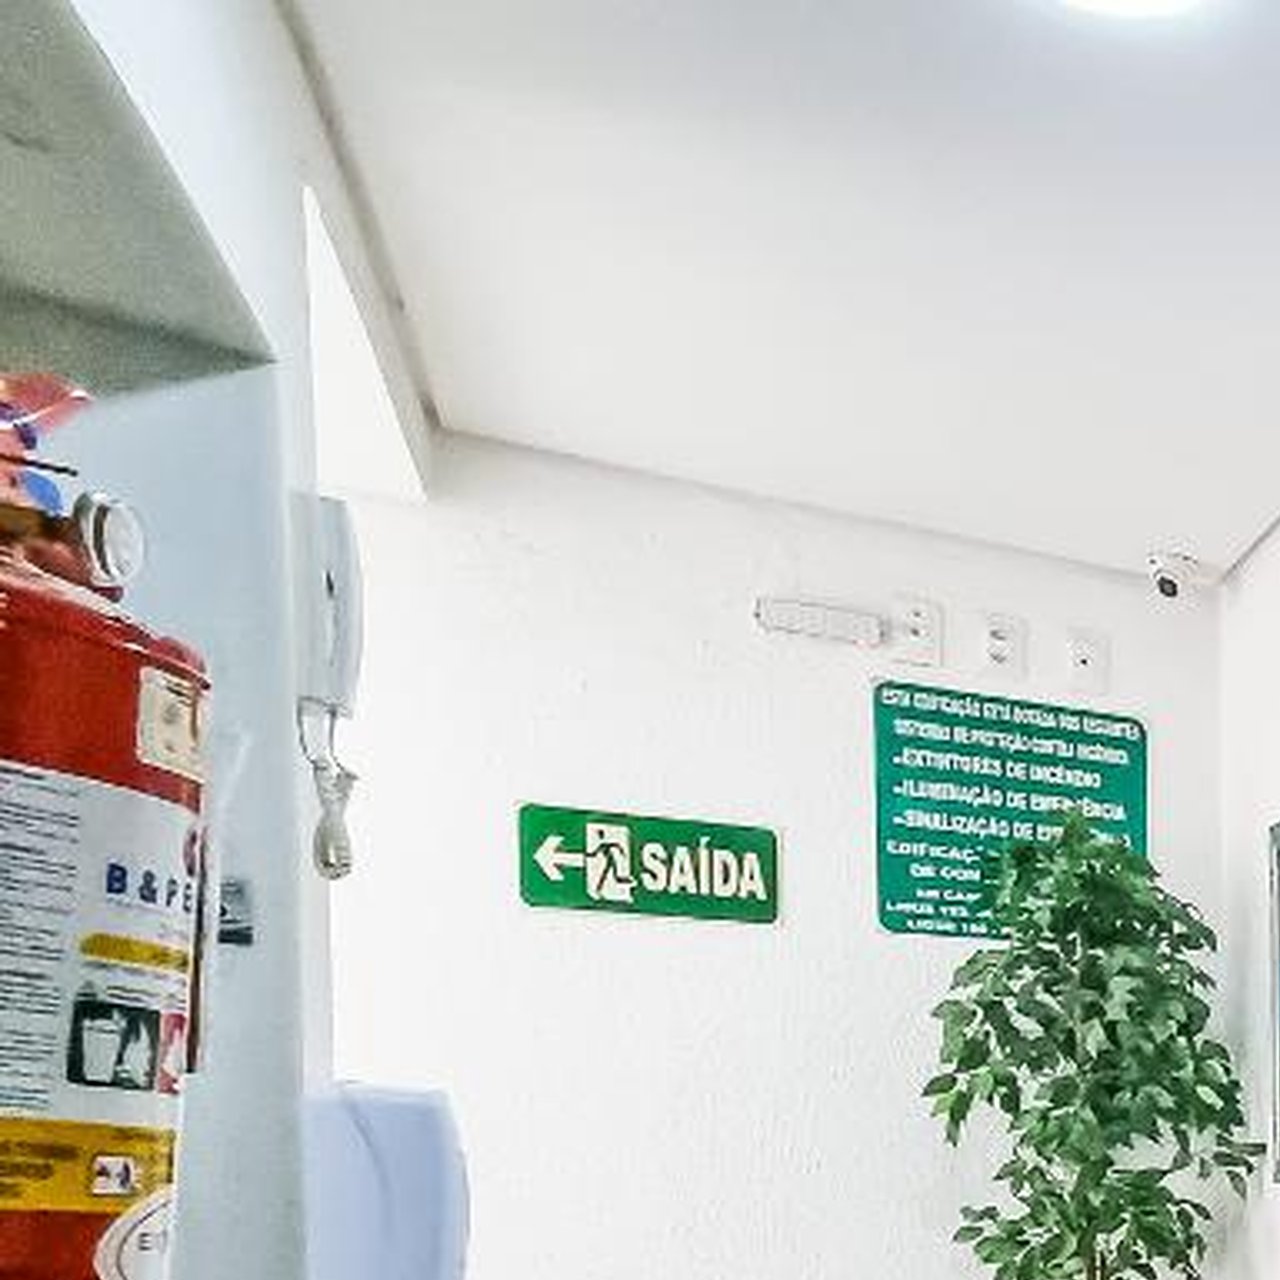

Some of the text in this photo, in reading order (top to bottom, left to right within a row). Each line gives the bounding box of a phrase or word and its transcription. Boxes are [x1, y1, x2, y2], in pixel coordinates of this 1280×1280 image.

[1006, 760, 1028, 781] DE
[1006, 791, 1028, 811] DE
[1012, 821, 1035, 841] DE
[641, 836, 767, 901] SAÍDA
[107, 863, 128, 894] B
[139, 870, 157, 904] &
